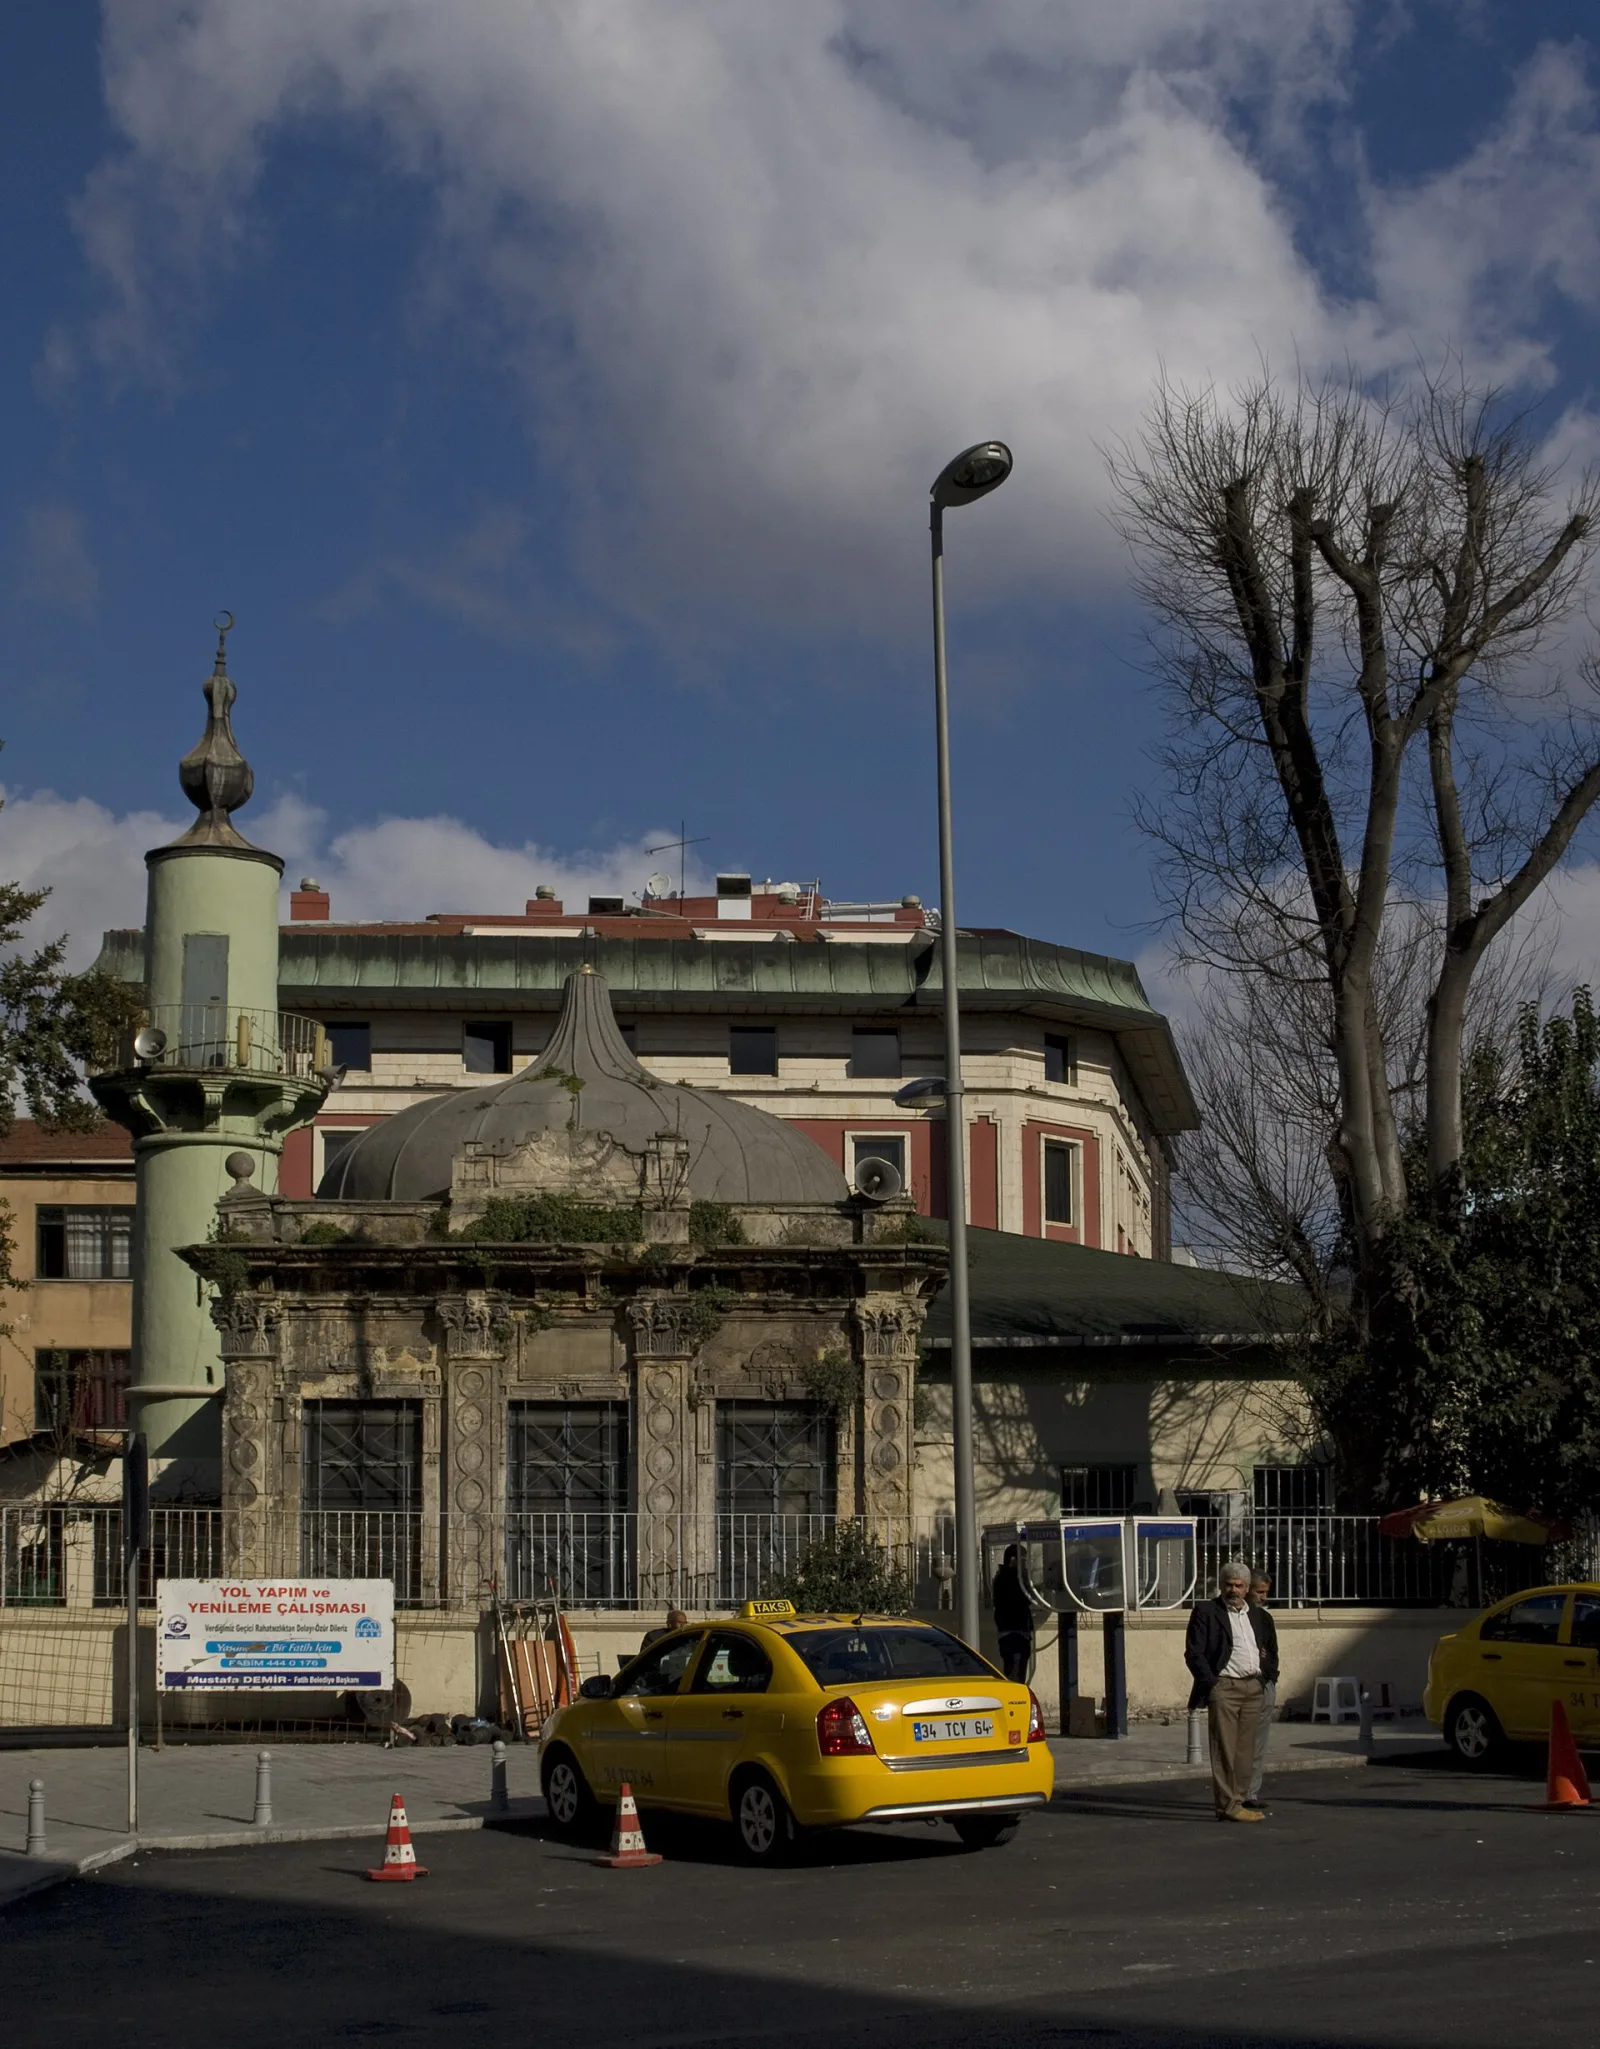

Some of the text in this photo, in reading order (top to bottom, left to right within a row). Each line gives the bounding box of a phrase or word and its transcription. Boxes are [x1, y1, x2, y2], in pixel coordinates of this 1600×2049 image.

[1427, 1525, 1466, 1534] ALGIDA
[220, 1587, 330, 1598] YOL YAPIM ve
[188, 1601, 366, 1616] YENİLEME ÇALIŞMASI
[272, 1643, 286, 1652] Bir
[288, 1643, 312, 1652] Fatih
[315, 1642, 332, 1653] İçin
[187, 1676, 239, 1684] Mustafa
[1570, 1692, 1585, 1708] 34
[921, 1720, 990, 1739] 34 TCY 64
